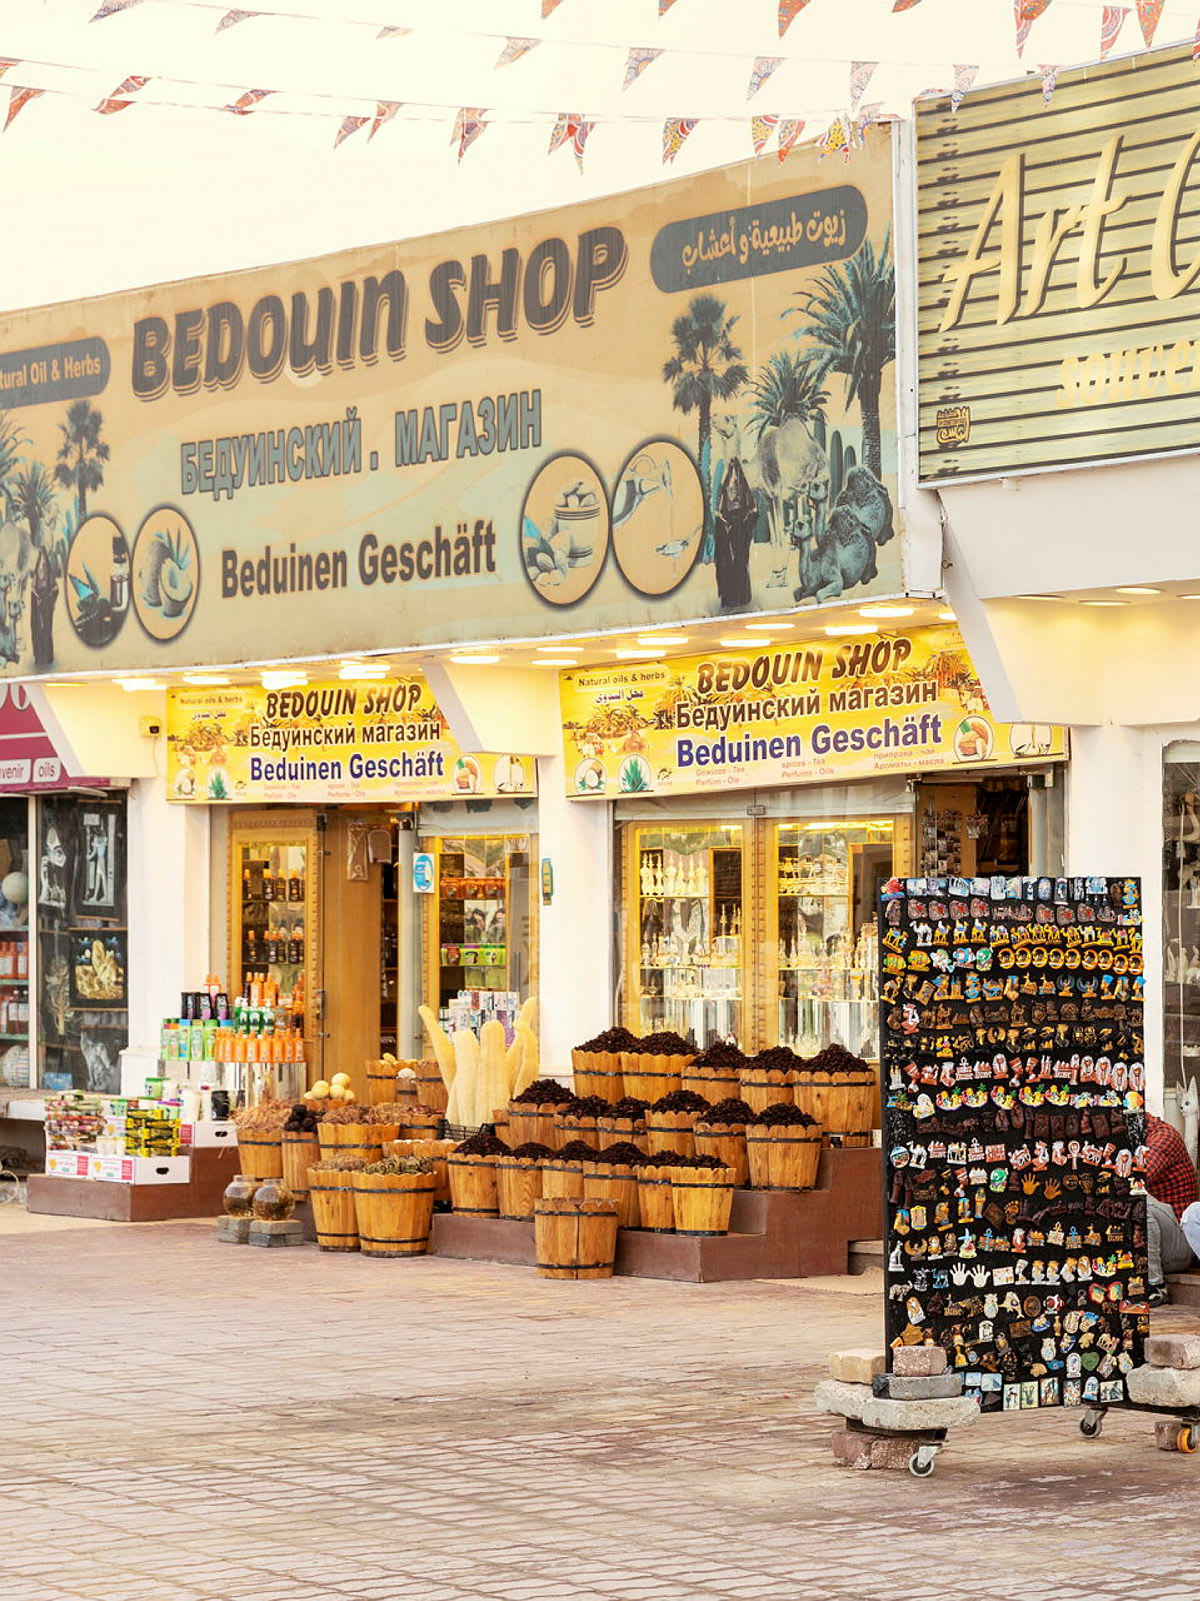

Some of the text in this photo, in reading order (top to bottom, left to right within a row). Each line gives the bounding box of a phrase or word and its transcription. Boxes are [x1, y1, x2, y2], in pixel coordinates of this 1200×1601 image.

[938, 135, 1131, 332] Art
[425, 226, 629, 353] SHOP
[31, 360, 47, 385] Oil
[51, 359, 60, 381] &
[63, 353, 101, 379] Herbs
[395, 389, 541, 467] МАГАЗИН
[221, 519, 496, 599] Beduinen Geschäft
[578, 676, 611, 687] Natural
[613, 674, 629, 684] oils
[640, 671, 666, 681] herbs
[697, 637, 912, 695] BEDOUIN SHOP
[266, 684, 422, 719] BEDOUIN SHOP
[677, 681, 938, 731] Бедуинский магазин
[250, 721, 441, 752] Бедуинский магазин
[677, 713, 942, 768] Beduinen Geschäft
[39, 762, 56, 778] oils
[250, 750, 444, 781] Beduinen Geschäft
